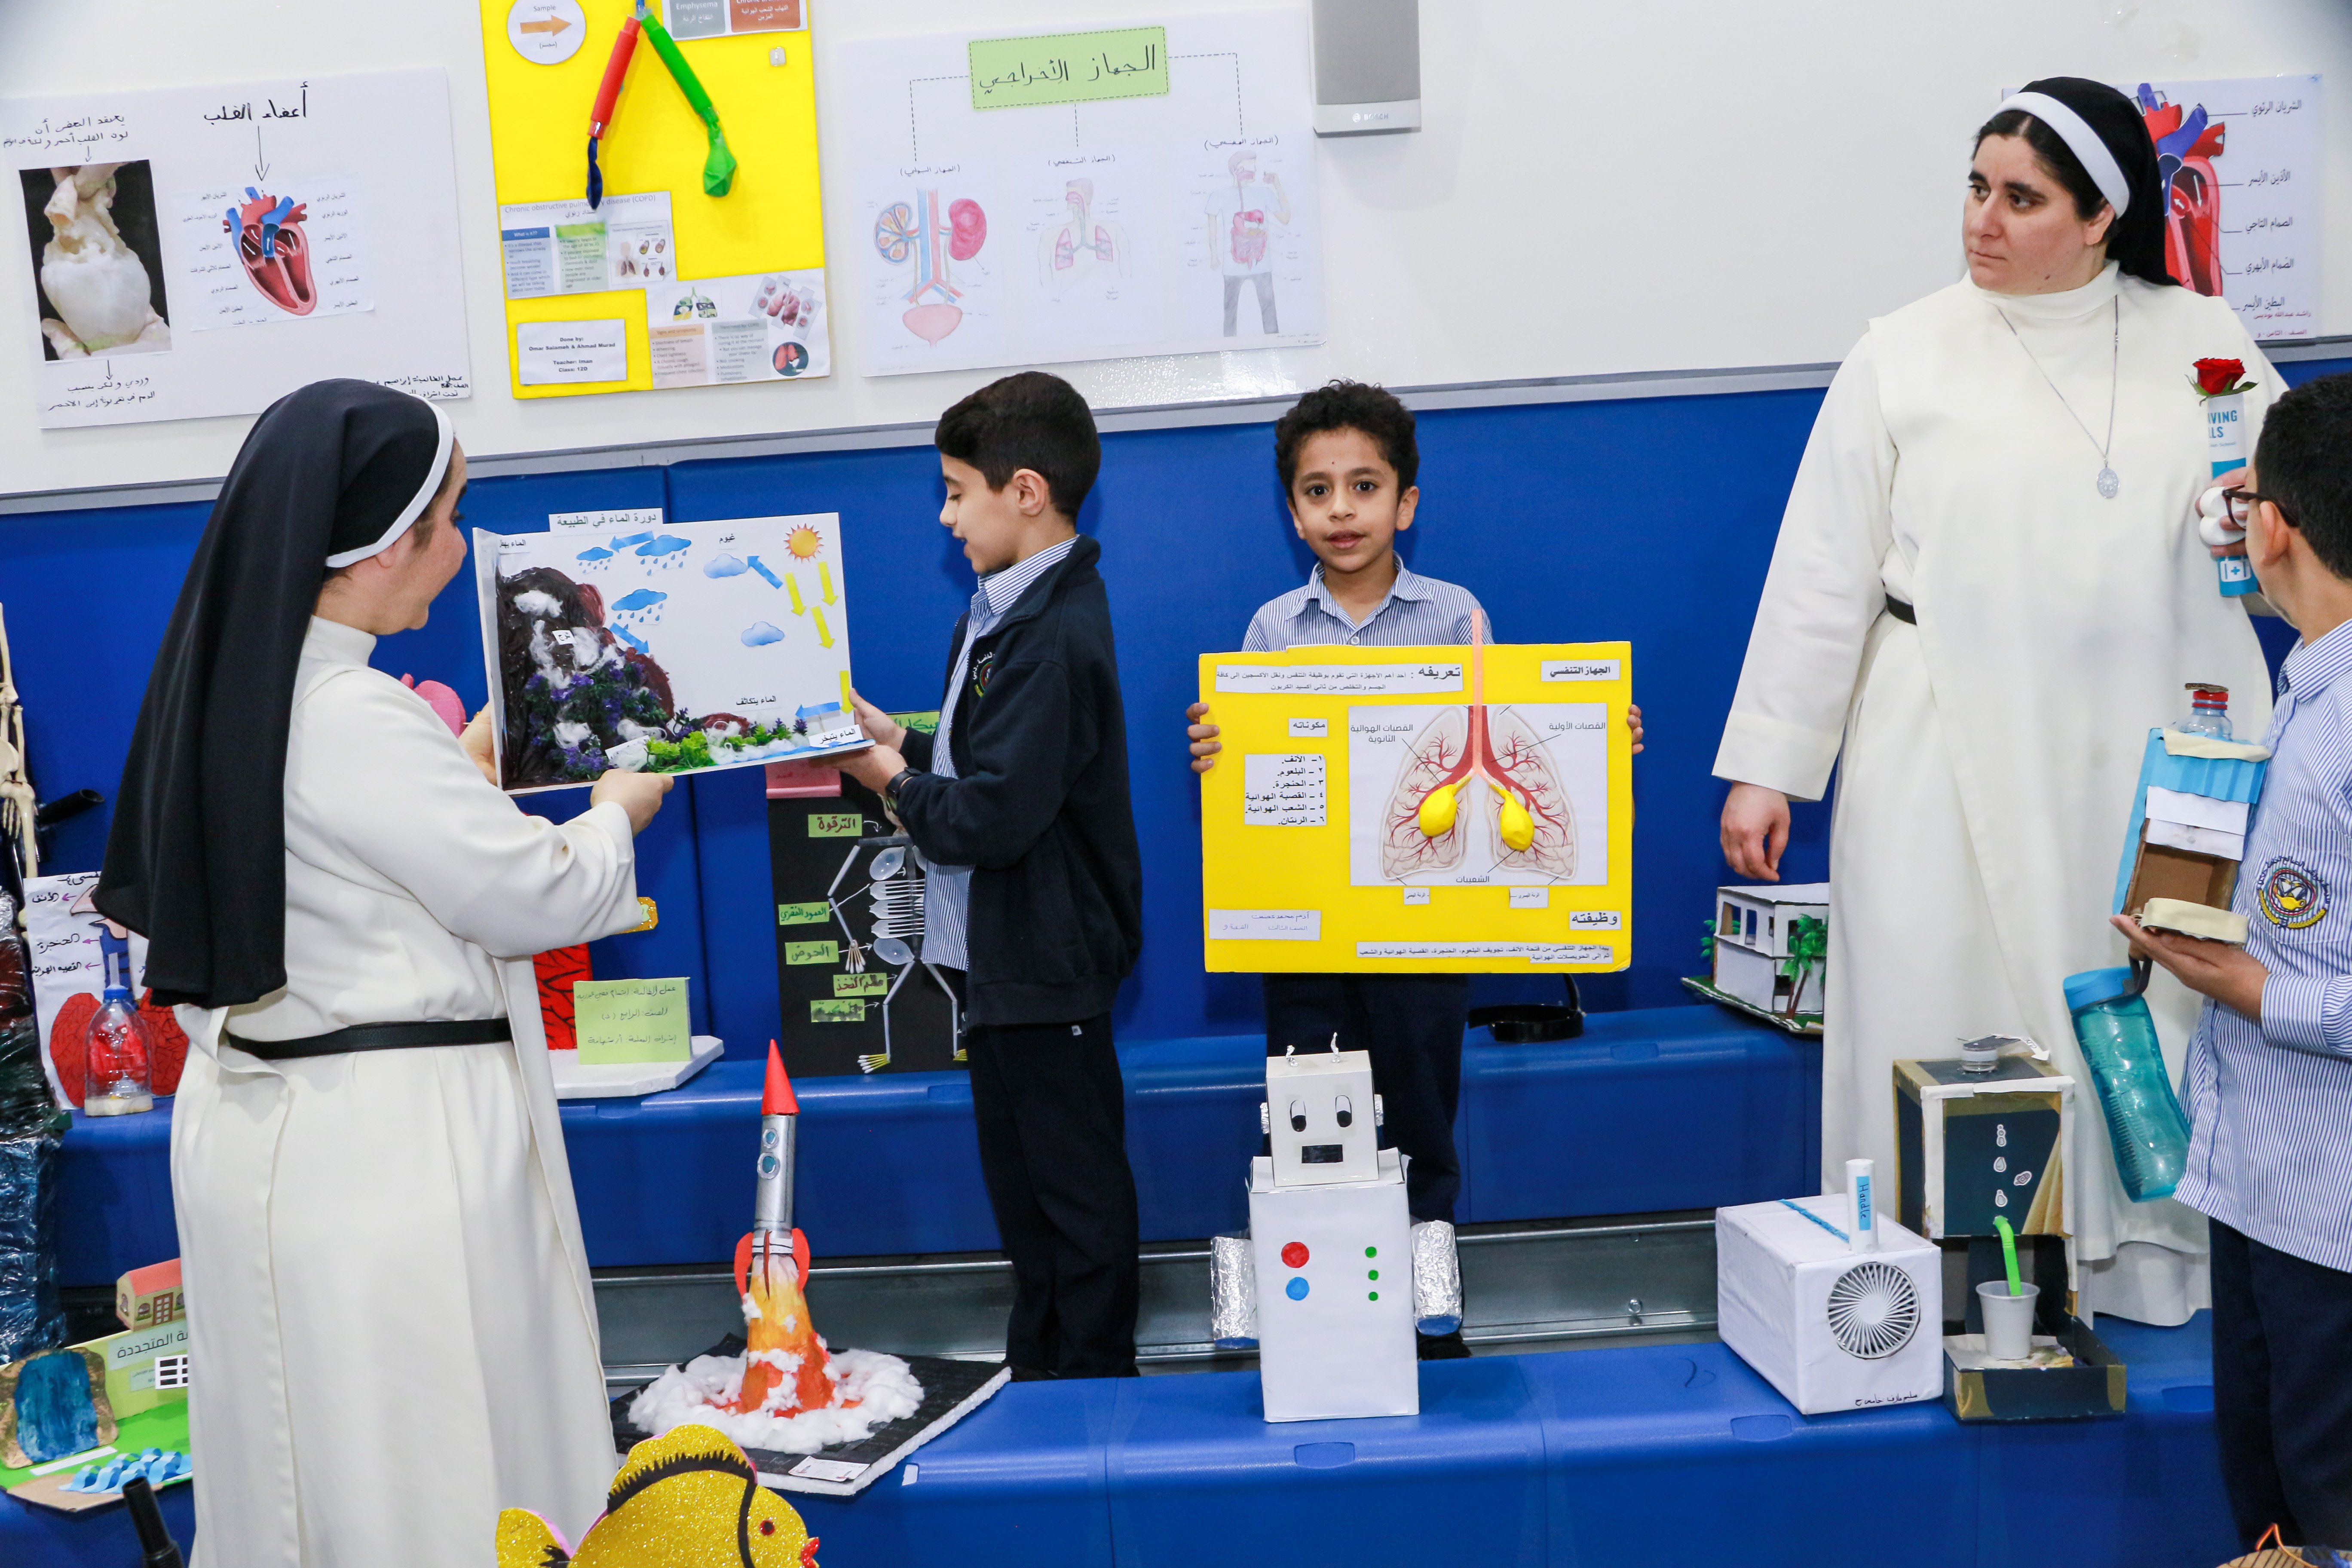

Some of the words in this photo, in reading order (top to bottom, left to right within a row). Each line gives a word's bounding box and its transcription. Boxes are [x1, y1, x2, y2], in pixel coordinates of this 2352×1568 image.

[676, 2, 718, 10] Emphysema
[1087, 44, 1155, 81] الجهاز
[2276, 100, 2302, 113] الشريان
[204, 102, 252, 125] القلب
[77, 132, 103, 145] القلب
[531, 202, 567, 211] obstructive
[632, 195, 656, 204] (COPD)
[139, 391, 155, 403] الدم
[557, 515, 588, 527] الطبيعة
[593, 514, 605, 528] في
[609, 513, 629, 524] الماء
[634, 513, 656, 524] دورة
[719, 533, 735, 545] غيوم
[1418, 666, 1460, 679] تعريفه
[1550, 666, 1583, 677] التنفسي
[1584, 666, 1610, 675] الجهاز
[736, 697, 758, 705] يتكاثف
[1293, 722, 1326, 730] مكوناته
[1351, 725, 1380, 733] الهوائية
[1549, 721, 1572, 731] الأولية
[1575, 722, 1605, 731] القصبات
[820, 734, 837, 744] يتبخر
[840, 728, 855, 738] الماء
[1369, 735, 1395, 744] الثانوية
[1245, 793, 1276, 802] الهوائية
[817, 815, 855, 833] الترقوة
[1456, 875, 1489, 884] الشعيبات
[781, 906, 803, 921] الفقري
[804, 907, 826, 920] العمود
[1572, 912, 1617, 926] وظيفته
[37, 933, 80, 954] الحنجرة
[792, 944, 829, 962] الحوض
[659, 984, 676, 994] عمل
[620, 1009, 639, 1020] الرابع
[1859, 1184, 1870, 1219] Handle
[118, 1333, 172, 1358] المتجددة
